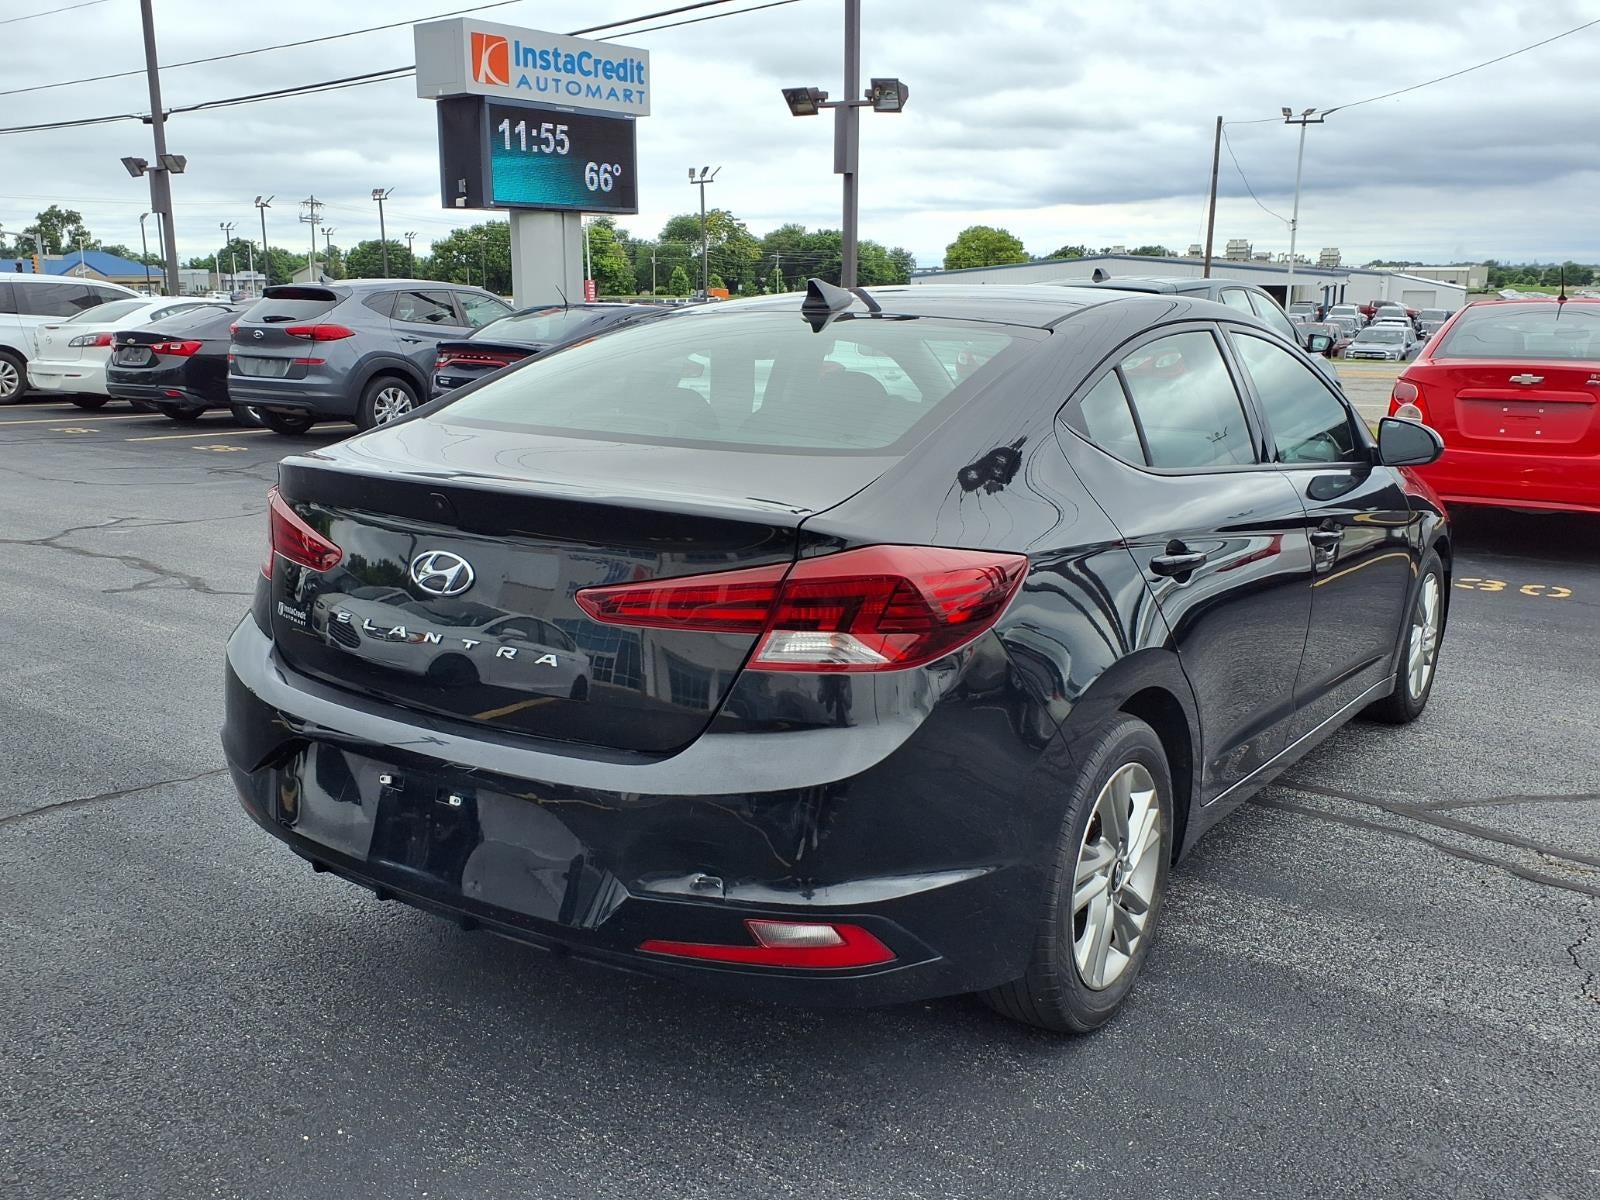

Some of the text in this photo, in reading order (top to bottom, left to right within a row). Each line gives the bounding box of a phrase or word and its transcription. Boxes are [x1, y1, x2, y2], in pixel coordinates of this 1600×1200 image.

[514, 40, 645, 85] InstaCredit
[516, 73, 645, 105] AUTOMART
[498, 118, 570, 155] 11:55
[336, 610, 559, 668] ELANTRA
